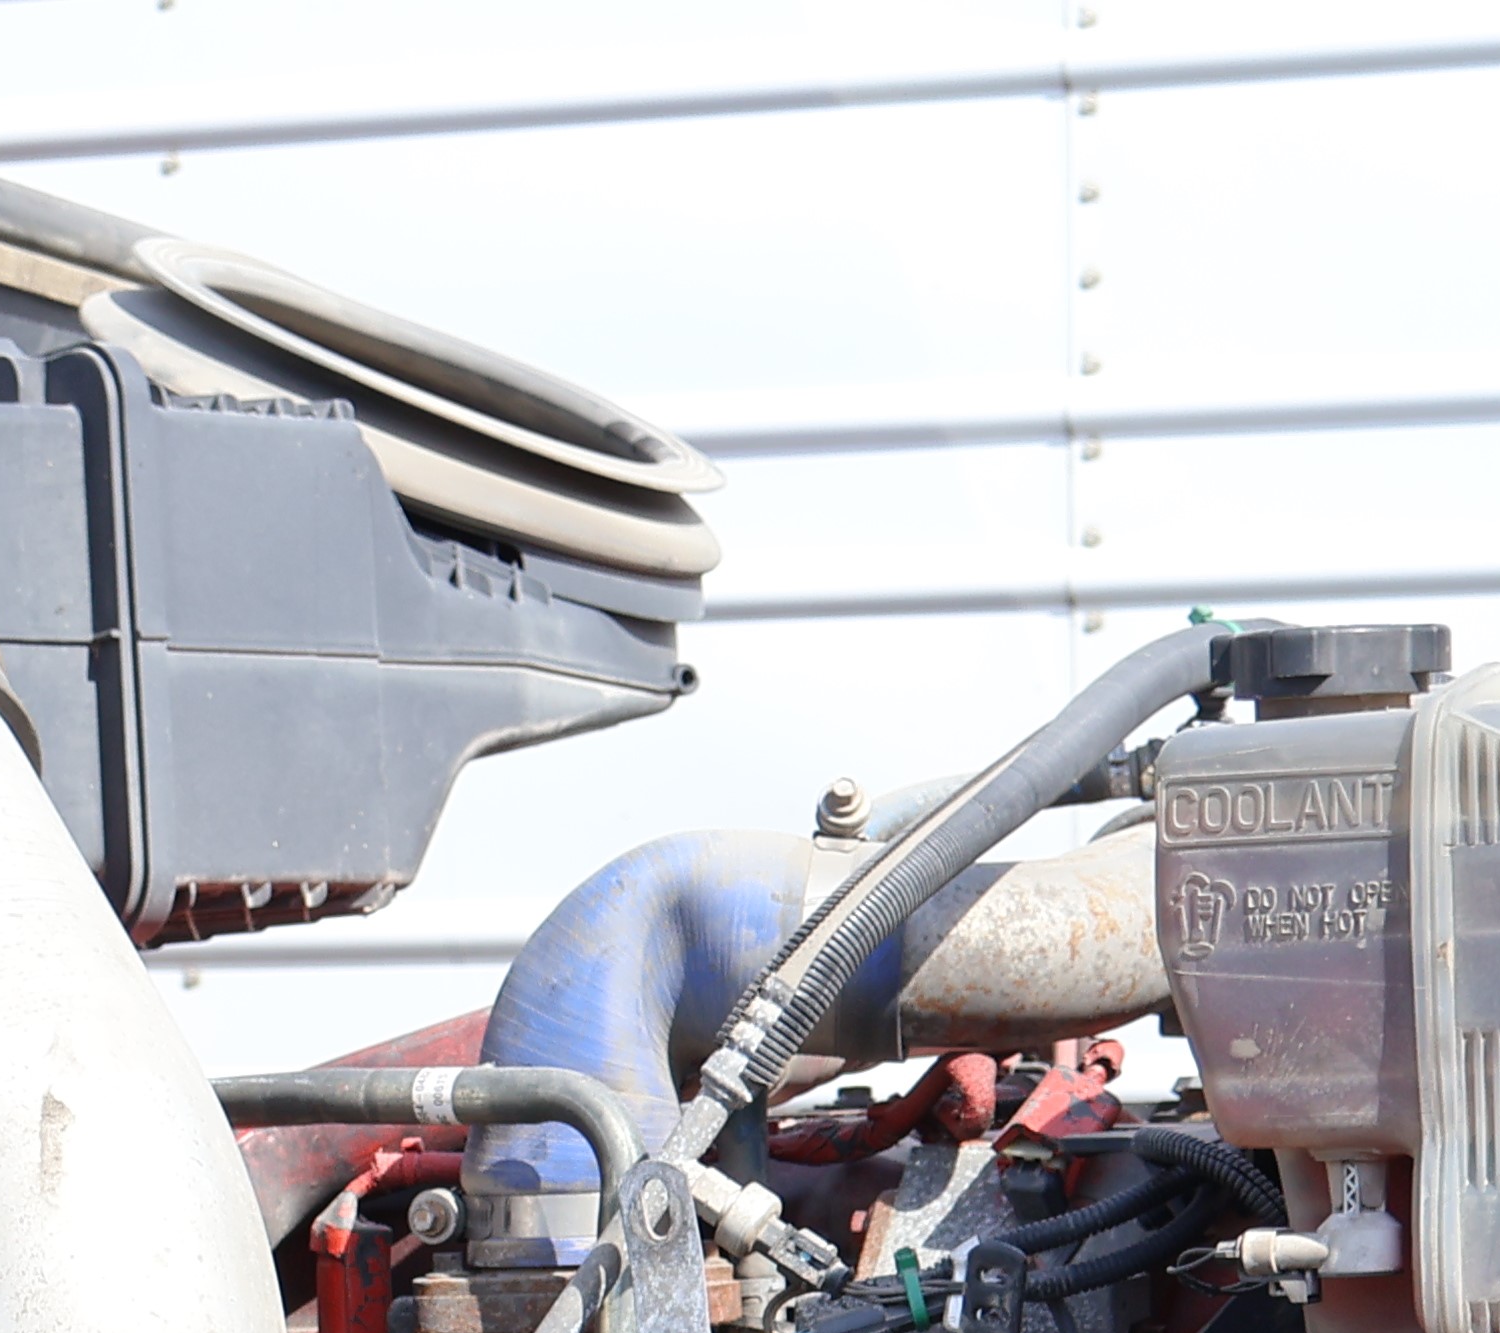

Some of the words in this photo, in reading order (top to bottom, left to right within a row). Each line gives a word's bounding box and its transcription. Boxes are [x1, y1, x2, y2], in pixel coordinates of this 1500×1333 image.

[1166, 774, 1393, 835] COOLANT
[1246, 886, 1277, 911] DO
[1289, 884, 1336, 912] NOT
[1349, 879, 1408, 909] OPEN
[1246, 912, 1310, 944] WHEN
[1321, 909, 1368, 941] HOT
